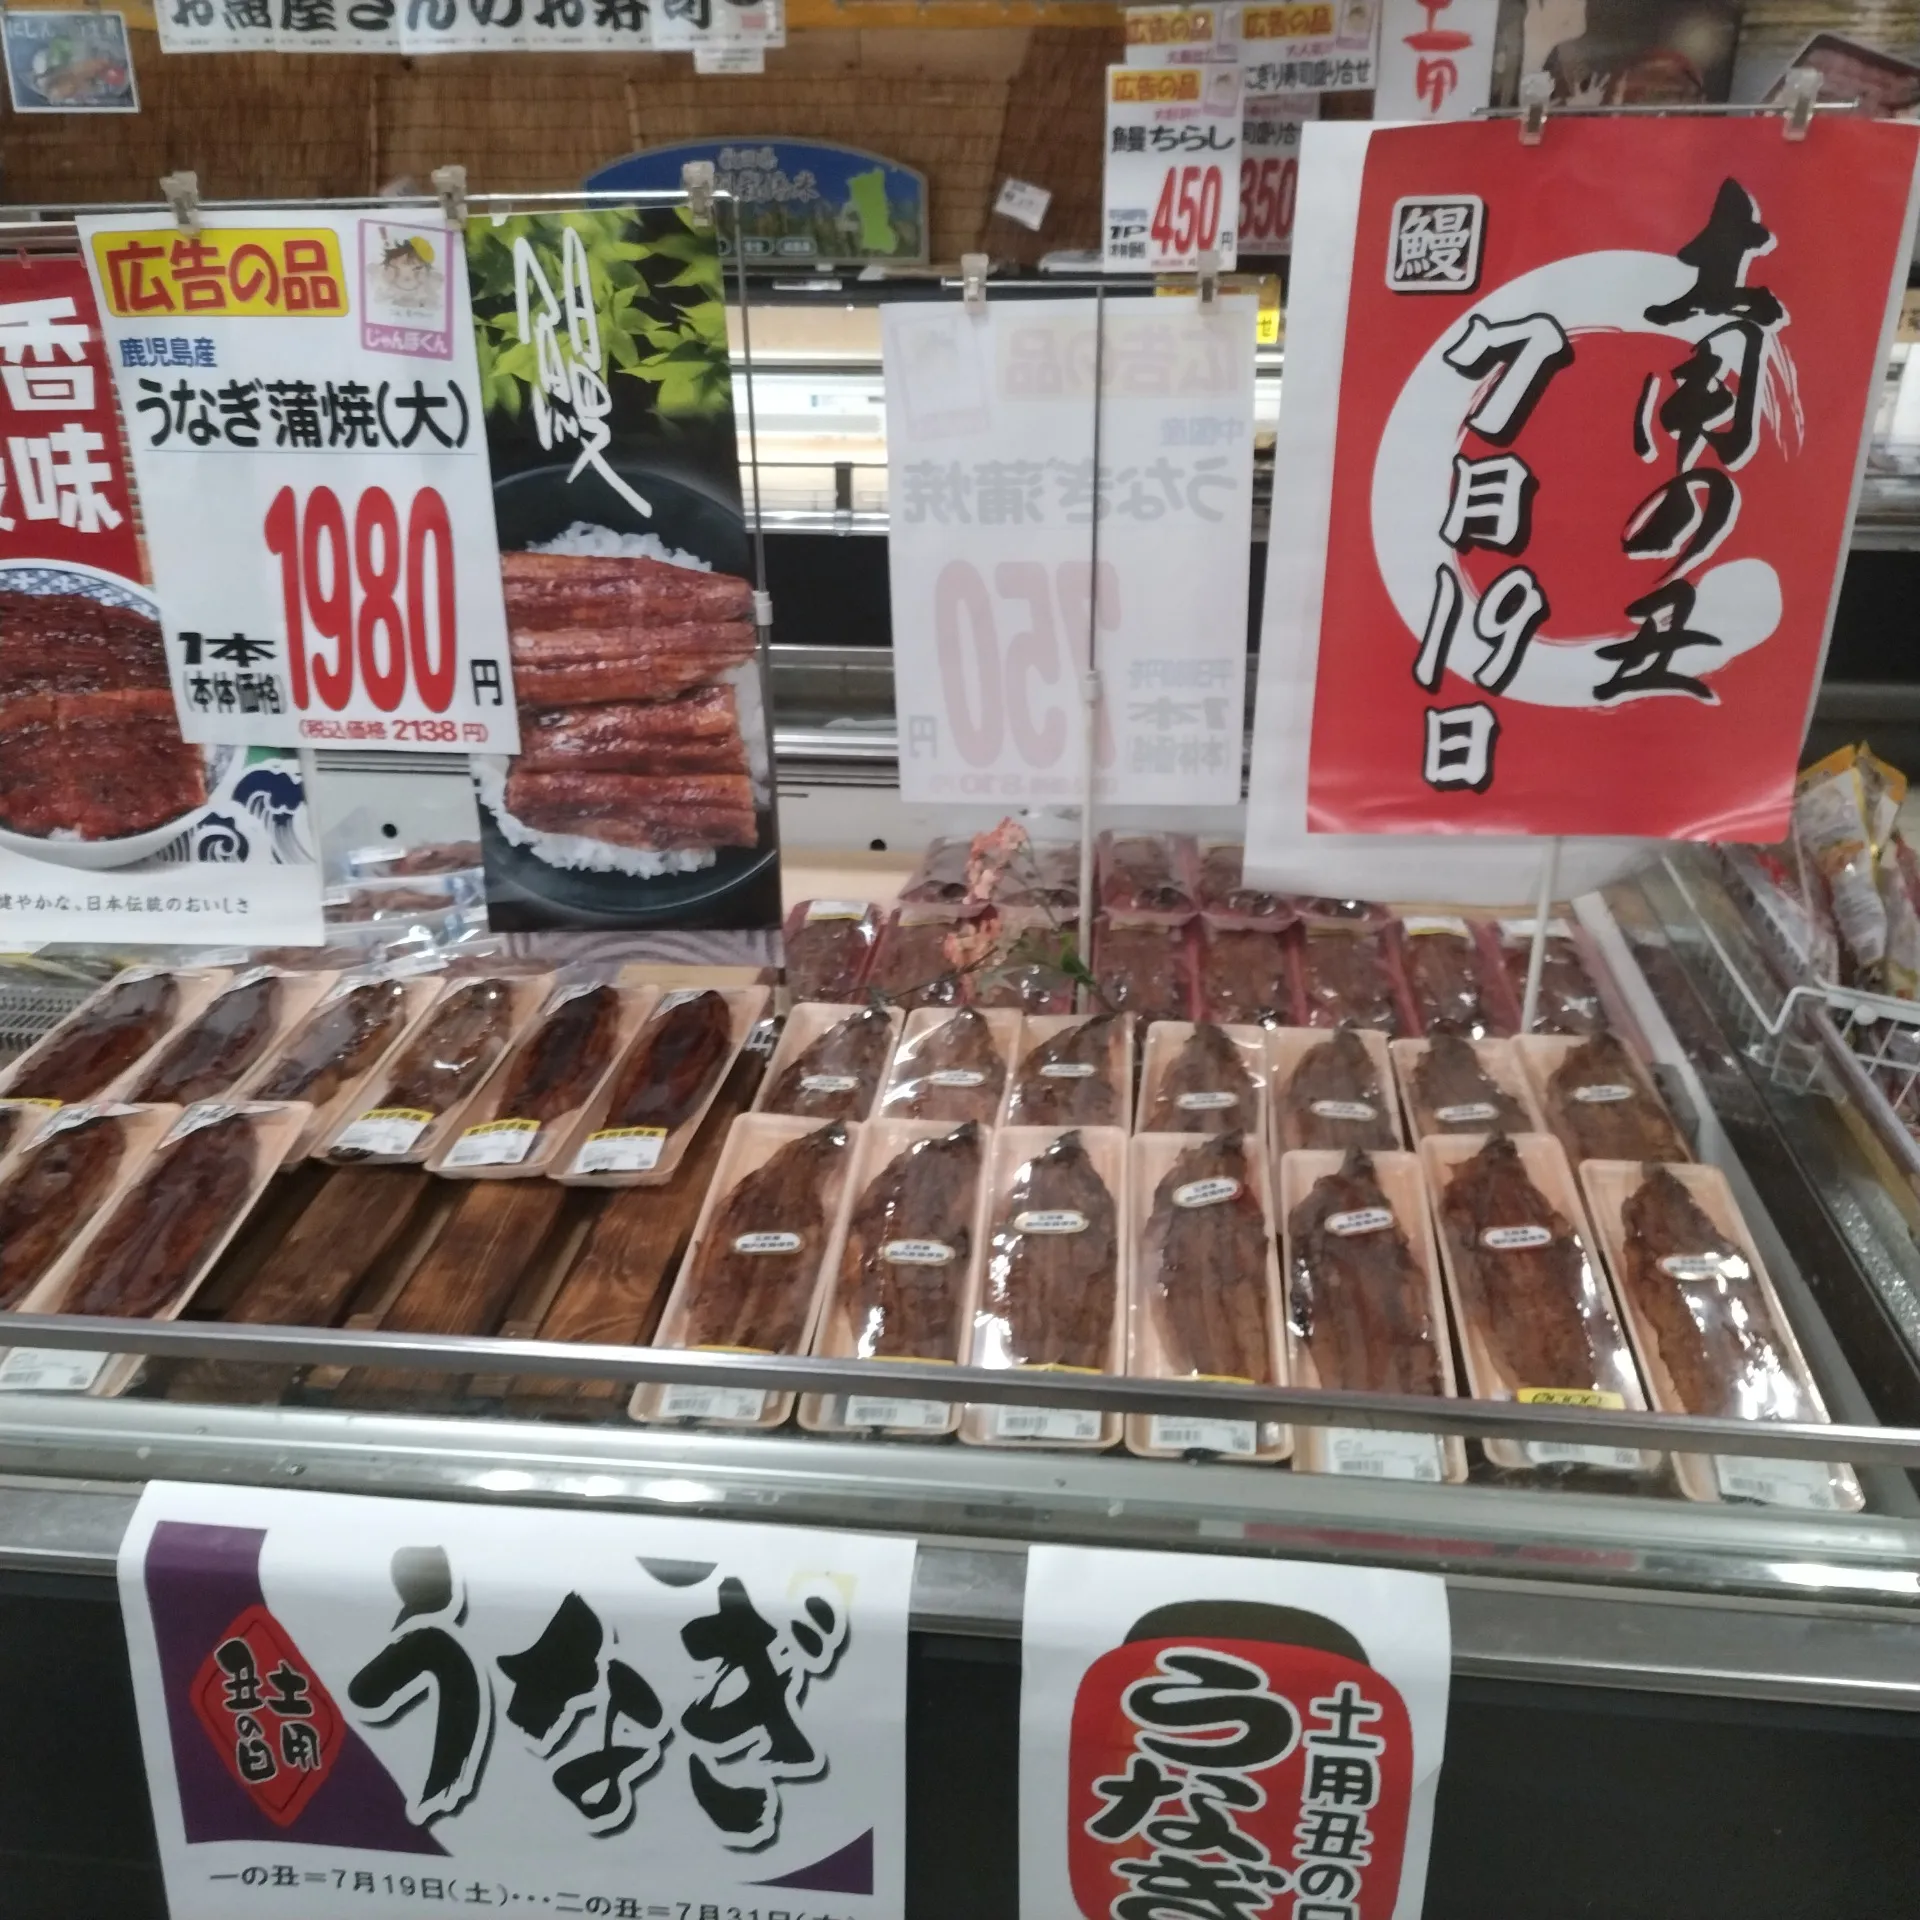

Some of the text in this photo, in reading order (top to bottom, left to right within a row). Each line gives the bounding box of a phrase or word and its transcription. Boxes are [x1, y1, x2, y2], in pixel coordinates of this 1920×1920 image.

[1151, 166, 1223, 255] 450
[105, 239, 341, 313] 広告の品
[119, 337, 218, 369] 鹿児島産
[136, 377, 470, 450] うなぎ蒲焼(大)
[264, 485, 458, 714] 1980
[178, 631, 279, 668] 1本
[470, 658, 503, 707] 円
[347, 1545, 850, 1851] うなぎ
[1086, 1647, 1301, 1920] うなぎ
